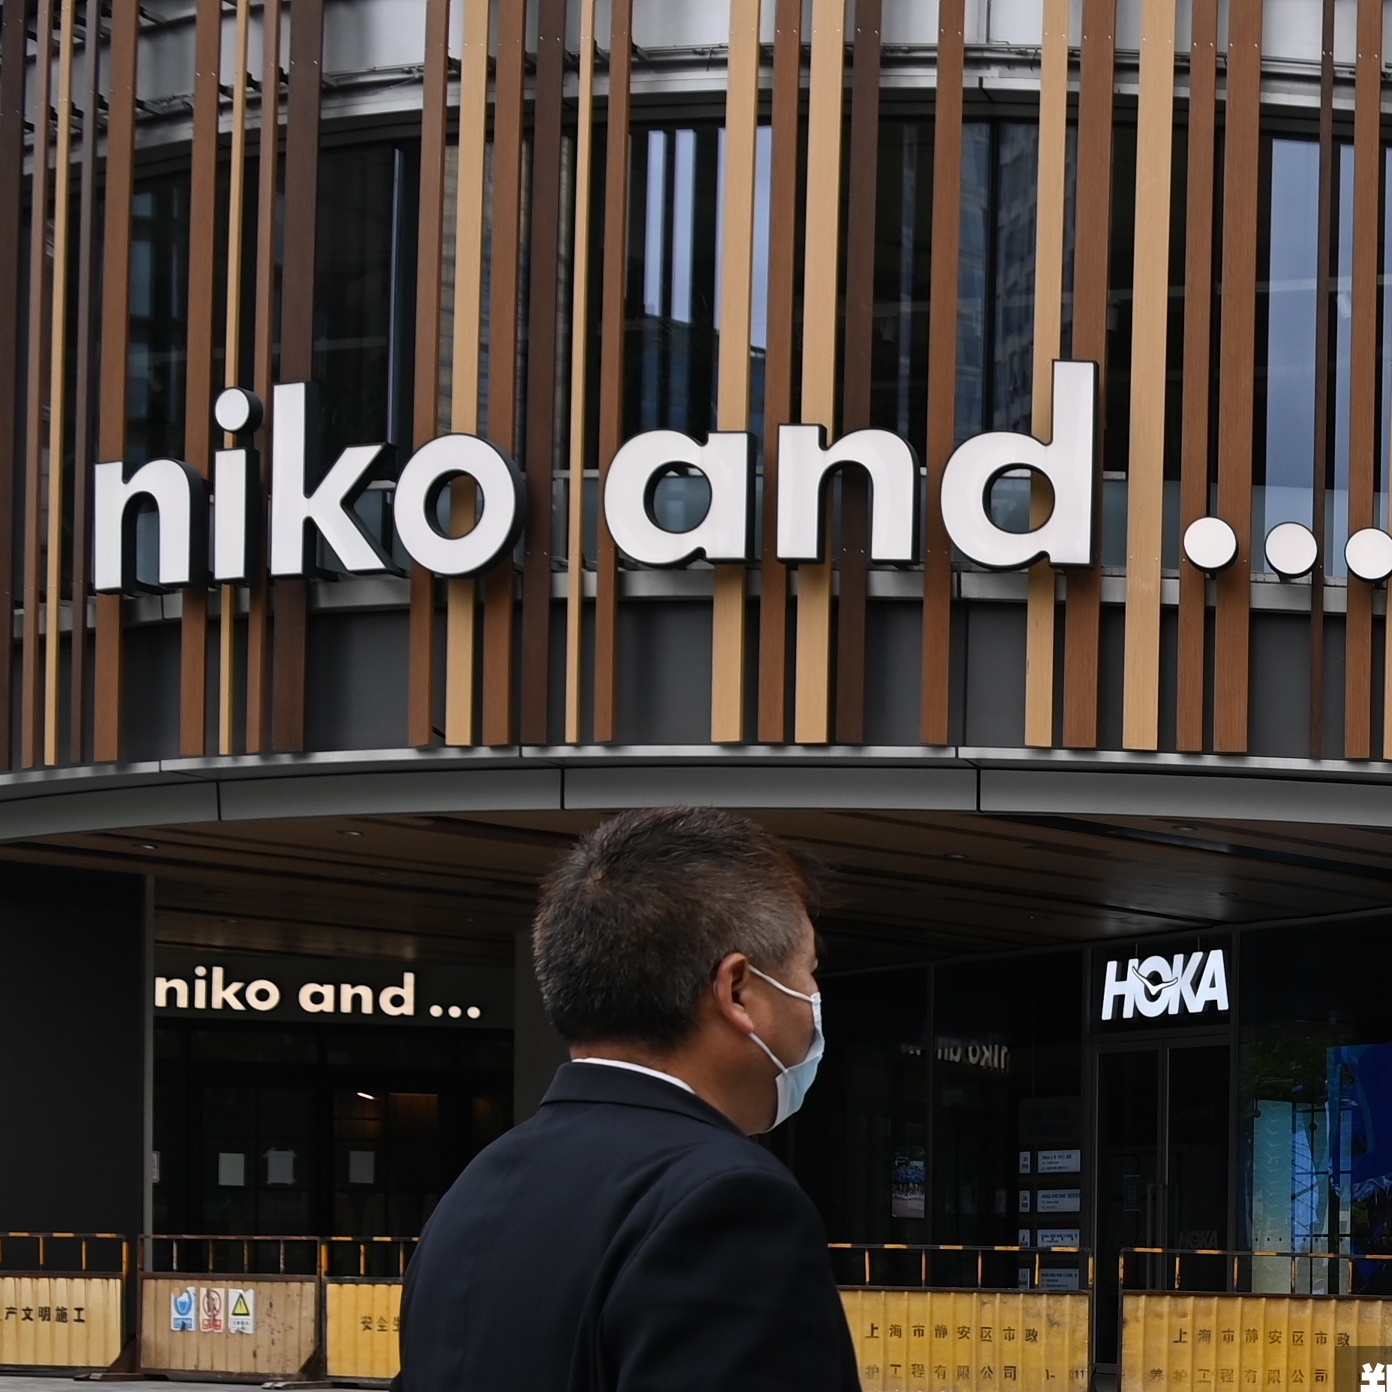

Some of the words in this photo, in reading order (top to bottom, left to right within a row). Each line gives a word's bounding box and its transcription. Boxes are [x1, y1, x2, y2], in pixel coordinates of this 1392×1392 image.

[95, 382, 523, 591] niko
[603, 359, 1098, 568] and
[154, 966, 280, 1011] niko
[299, 972, 414, 1016] and
[1101, 949, 1229, 1020] HOKA
[0, 1306, 86, 1323] 产文明施工
[865, 1322, 1040, 1343] 上海市静安区市政
[1172, 1326, 1351, 1347] 上海市静安区市政
[1150, 1366, 1330, 1386] 养护工程有限公司
